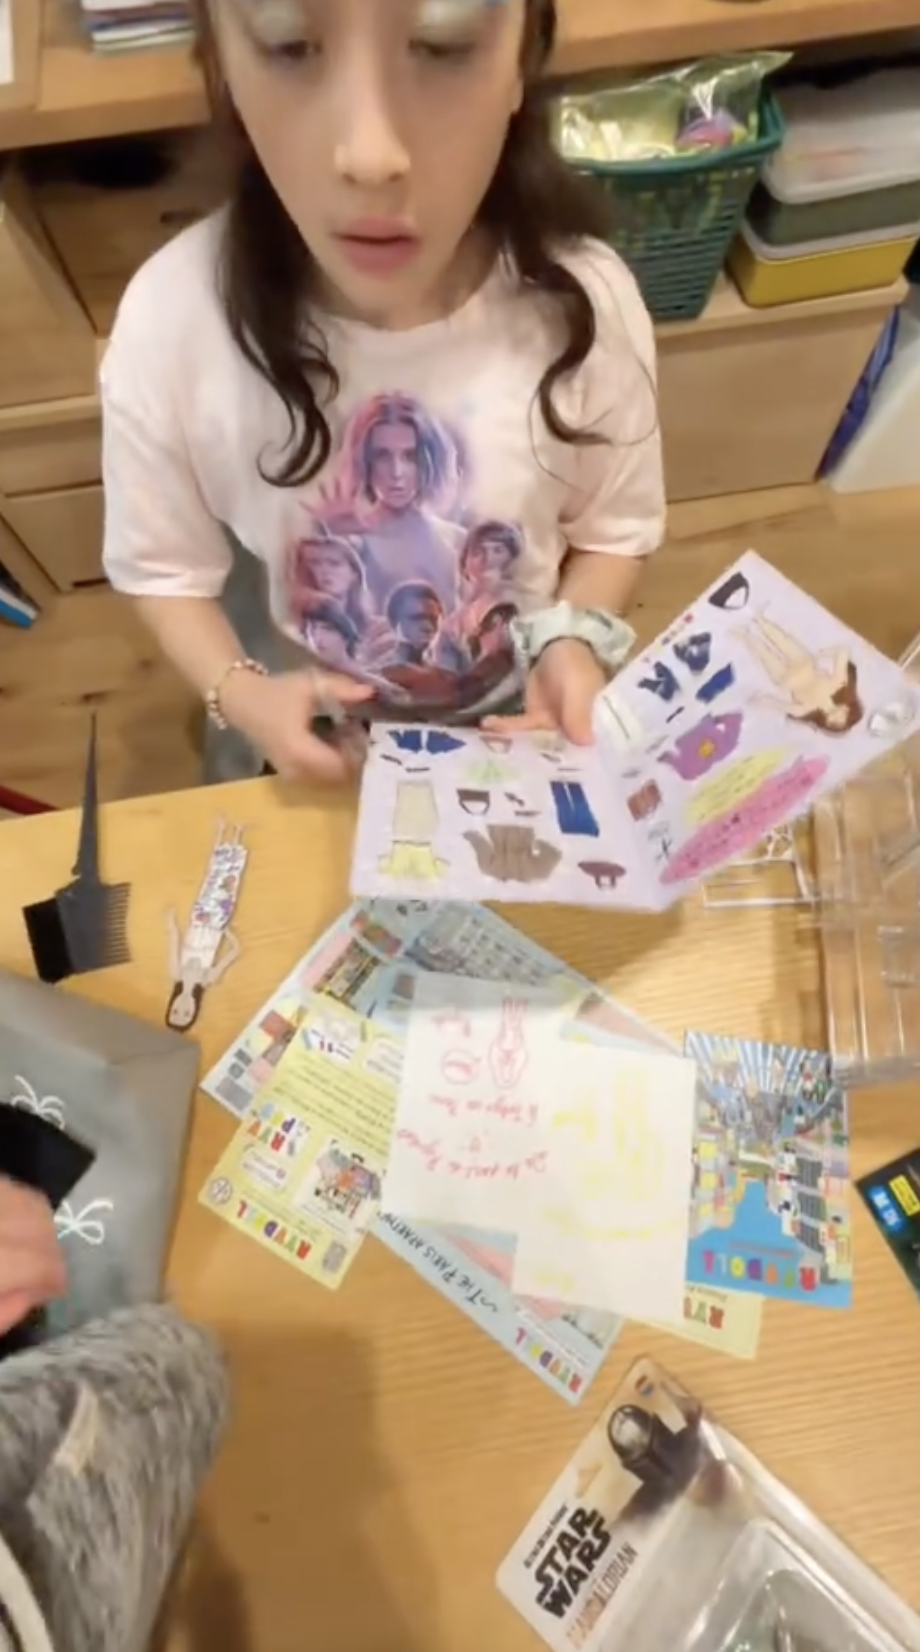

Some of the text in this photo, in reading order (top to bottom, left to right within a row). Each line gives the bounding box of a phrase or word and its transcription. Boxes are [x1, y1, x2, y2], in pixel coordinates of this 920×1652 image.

[422, 1245, 457, 1282] PARIS
[458, 1274, 482, 1304] THE
[535, 1508, 600, 1603] STAR
[542, 1518, 610, 1617] WARS
